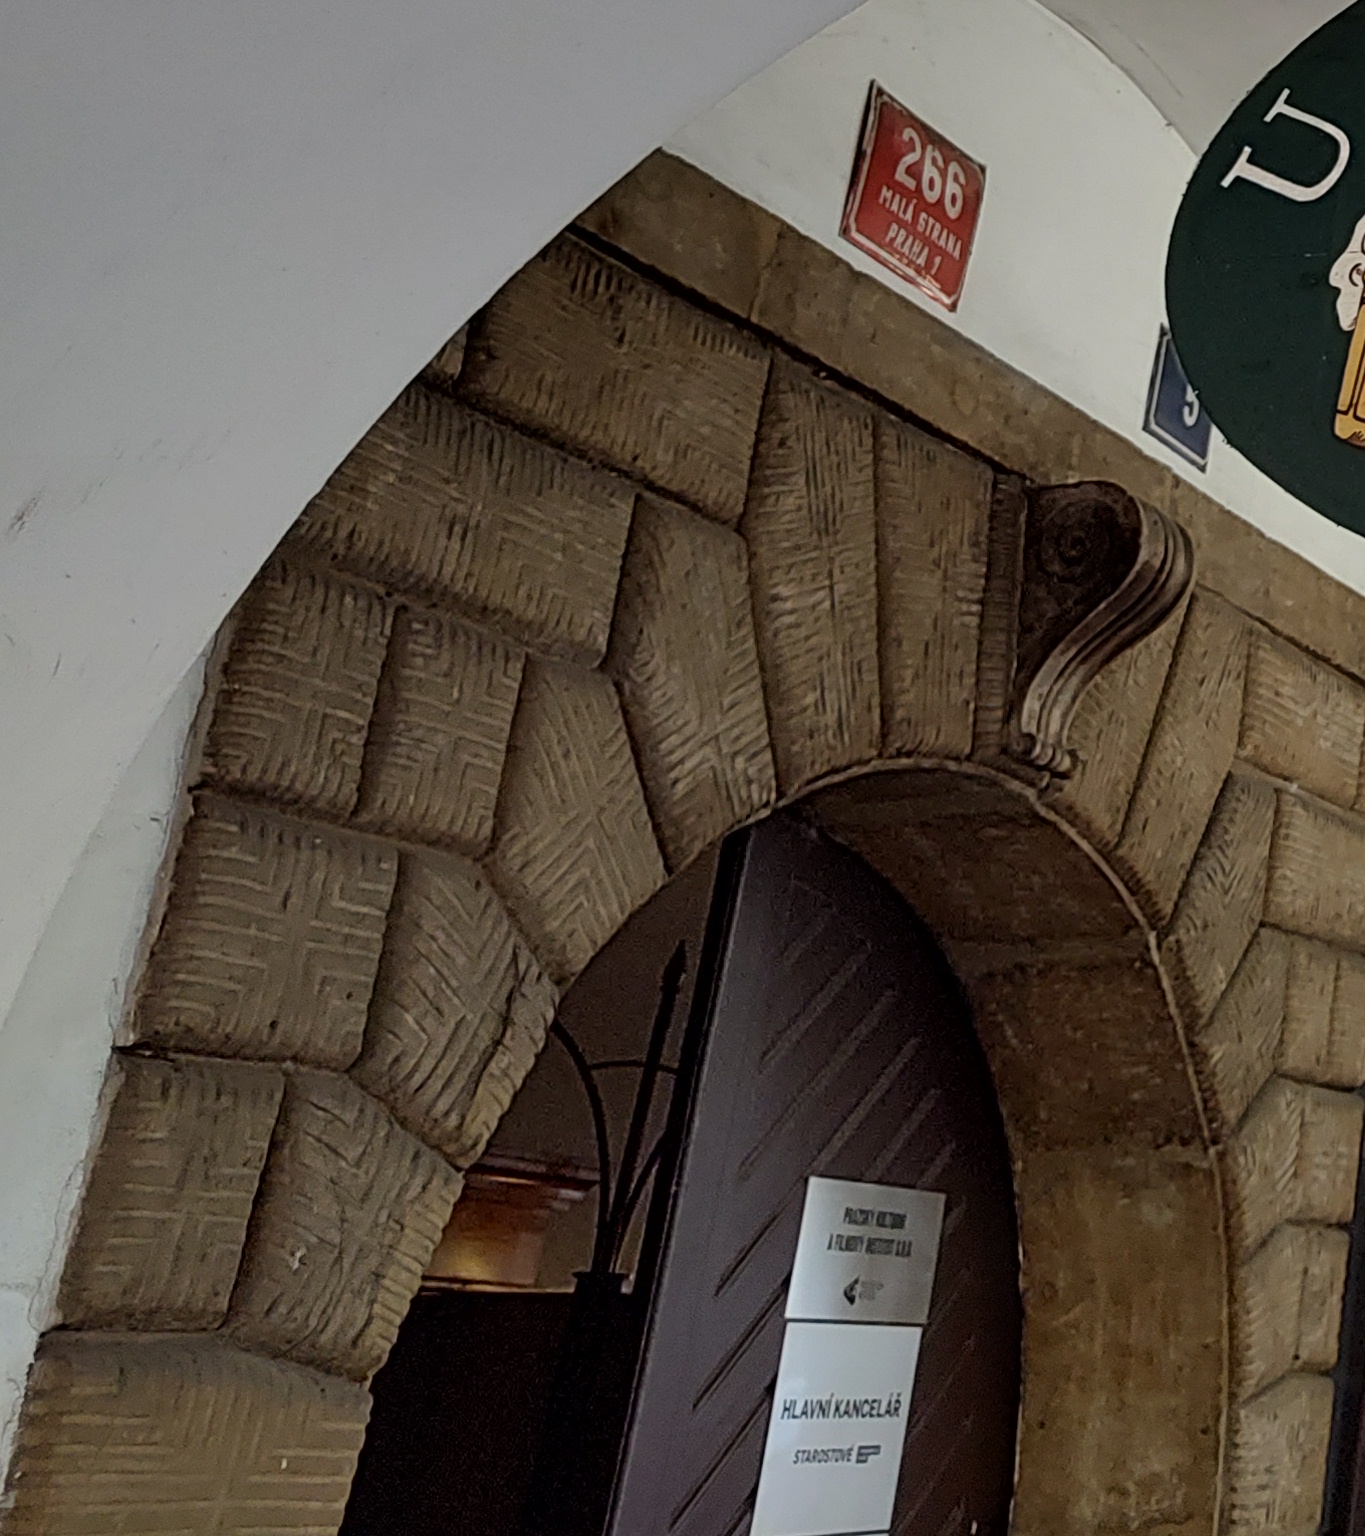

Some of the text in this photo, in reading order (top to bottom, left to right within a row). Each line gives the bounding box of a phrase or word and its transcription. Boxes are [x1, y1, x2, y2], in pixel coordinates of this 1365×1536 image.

[894, 127, 966, 220] 266
[1221, 87, 1350, 203] U
[878, 184, 963, 261] MALÁ STRANA
[885, 221, 942, 276] PRAHA 1
[781, 1392, 902, 1420] HLAVNÍ KANCELÁŘ
[793, 1444, 854, 1465] STAROSTOVÉ
